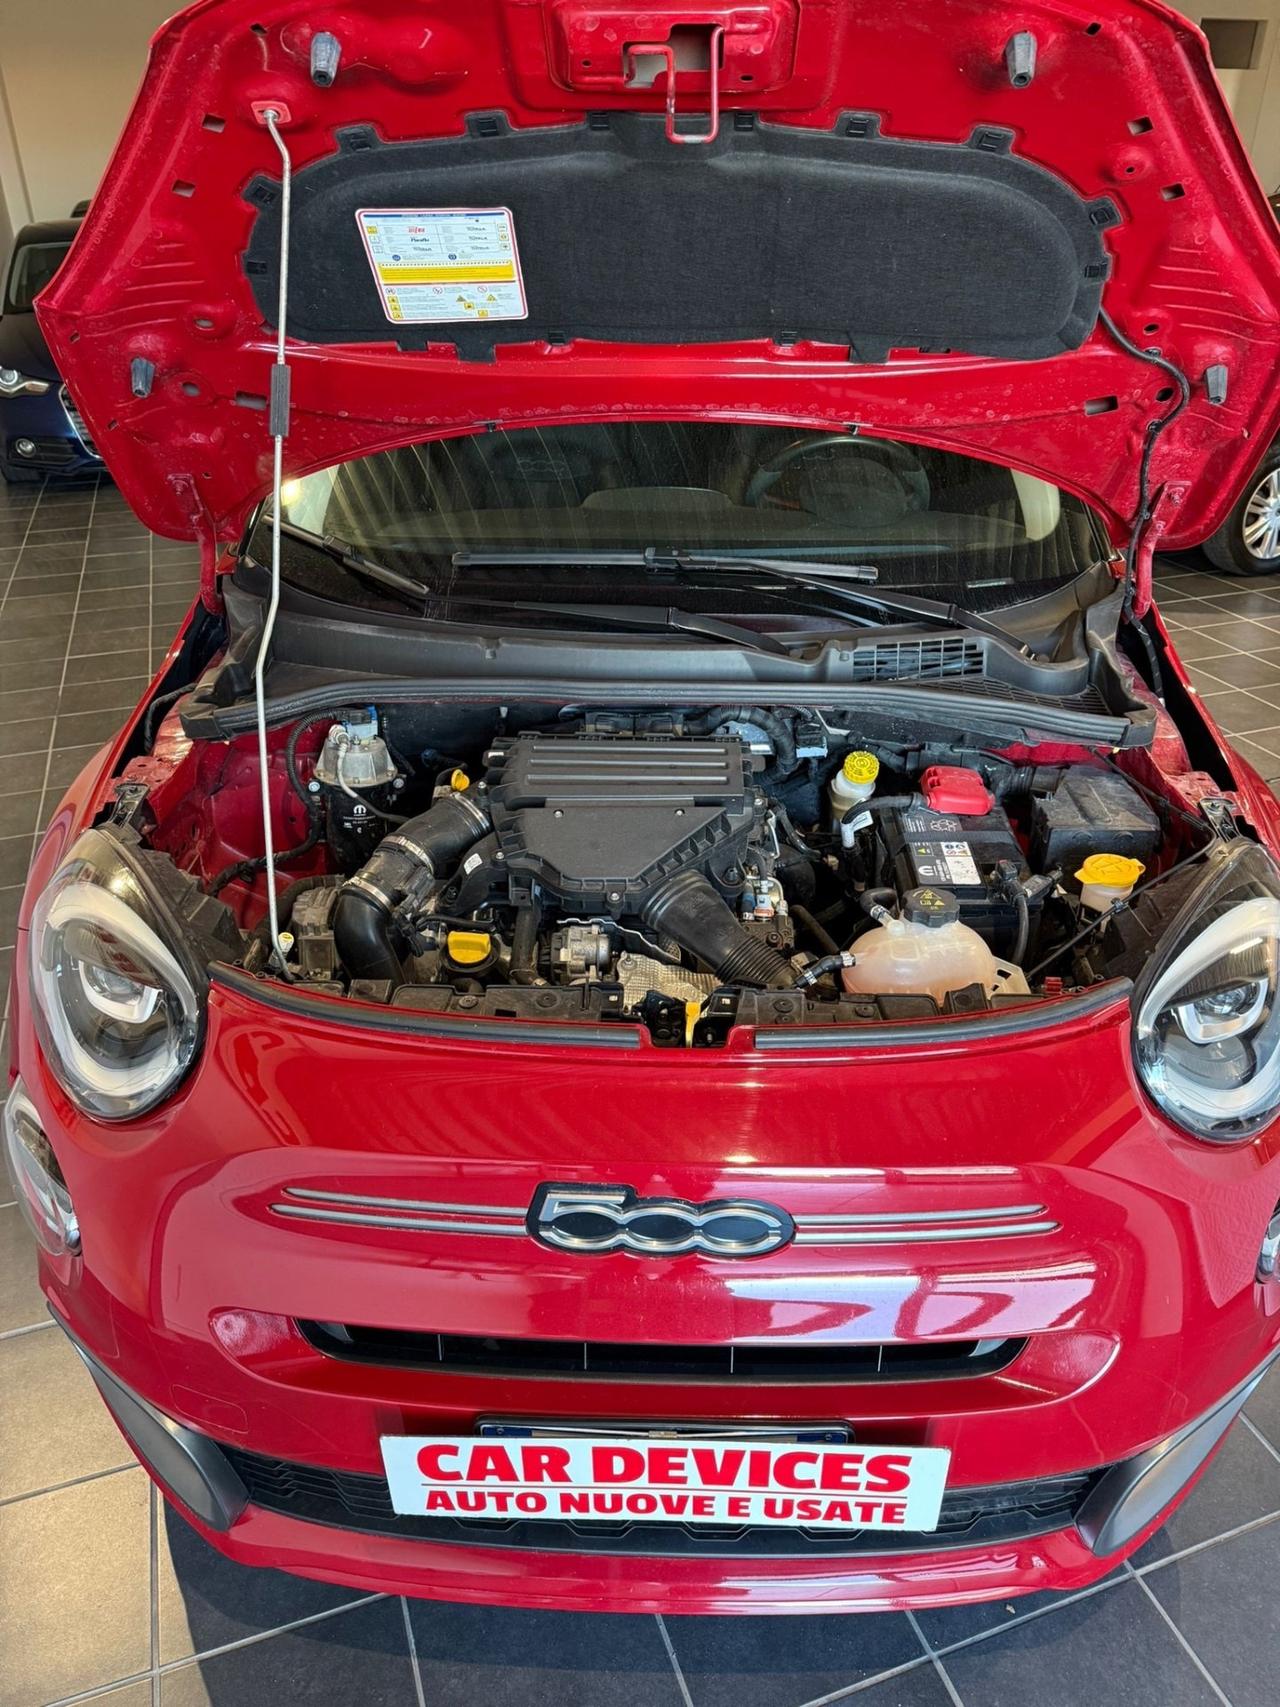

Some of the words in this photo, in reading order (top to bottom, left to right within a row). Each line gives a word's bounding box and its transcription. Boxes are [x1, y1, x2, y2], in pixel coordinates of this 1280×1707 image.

[538, 1191, 782, 1254] 500
[416, 1444, 571, 1483] CAR
[591, 1446, 912, 1493] DEVICES
[425, 1489, 548, 1514] AUTO
[559, 1492, 714, 1517] NUOVE
[727, 1496, 750, 1518] E
[763, 1497, 906, 1525] USATE
